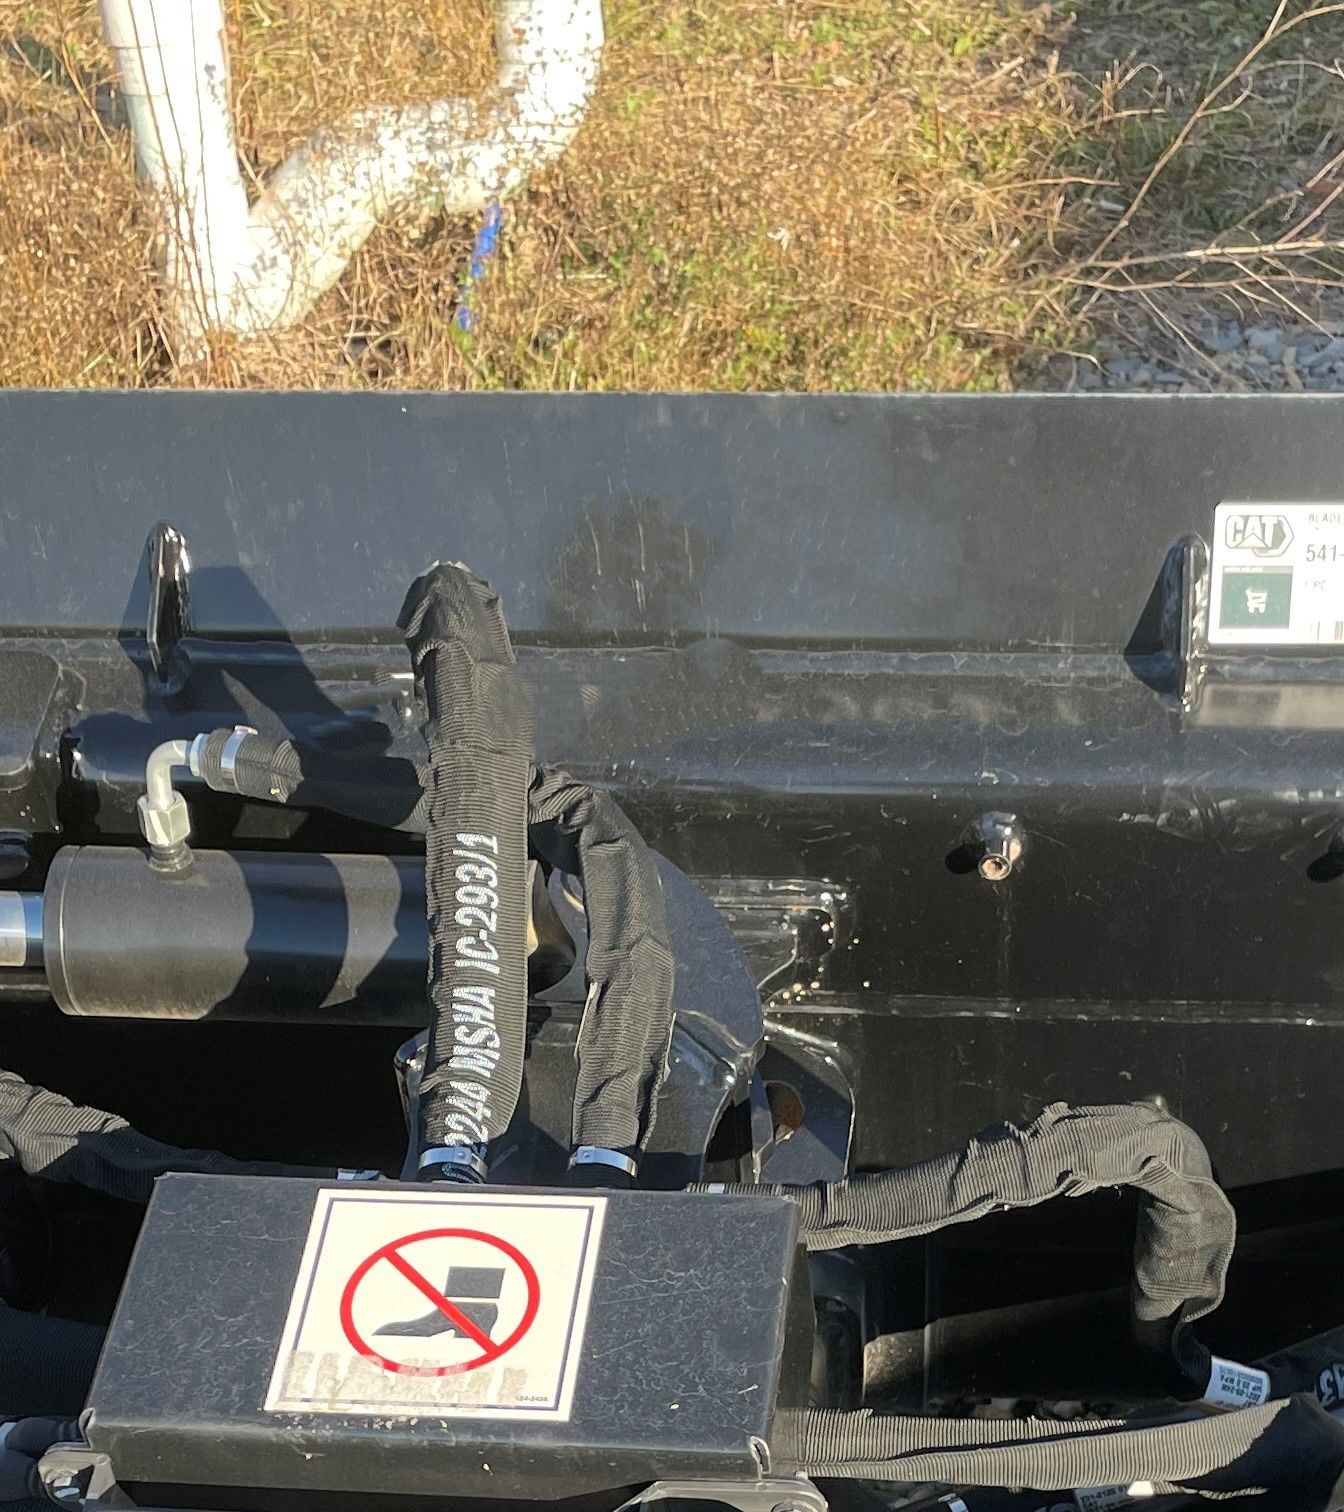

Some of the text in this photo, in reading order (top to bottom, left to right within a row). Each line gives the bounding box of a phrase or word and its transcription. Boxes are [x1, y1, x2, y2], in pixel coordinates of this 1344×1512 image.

[1225, 514, 1281, 549] CAT
[452, 832, 501, 975] IC-293/1
[448, 985, 501, 1078] MSHA
